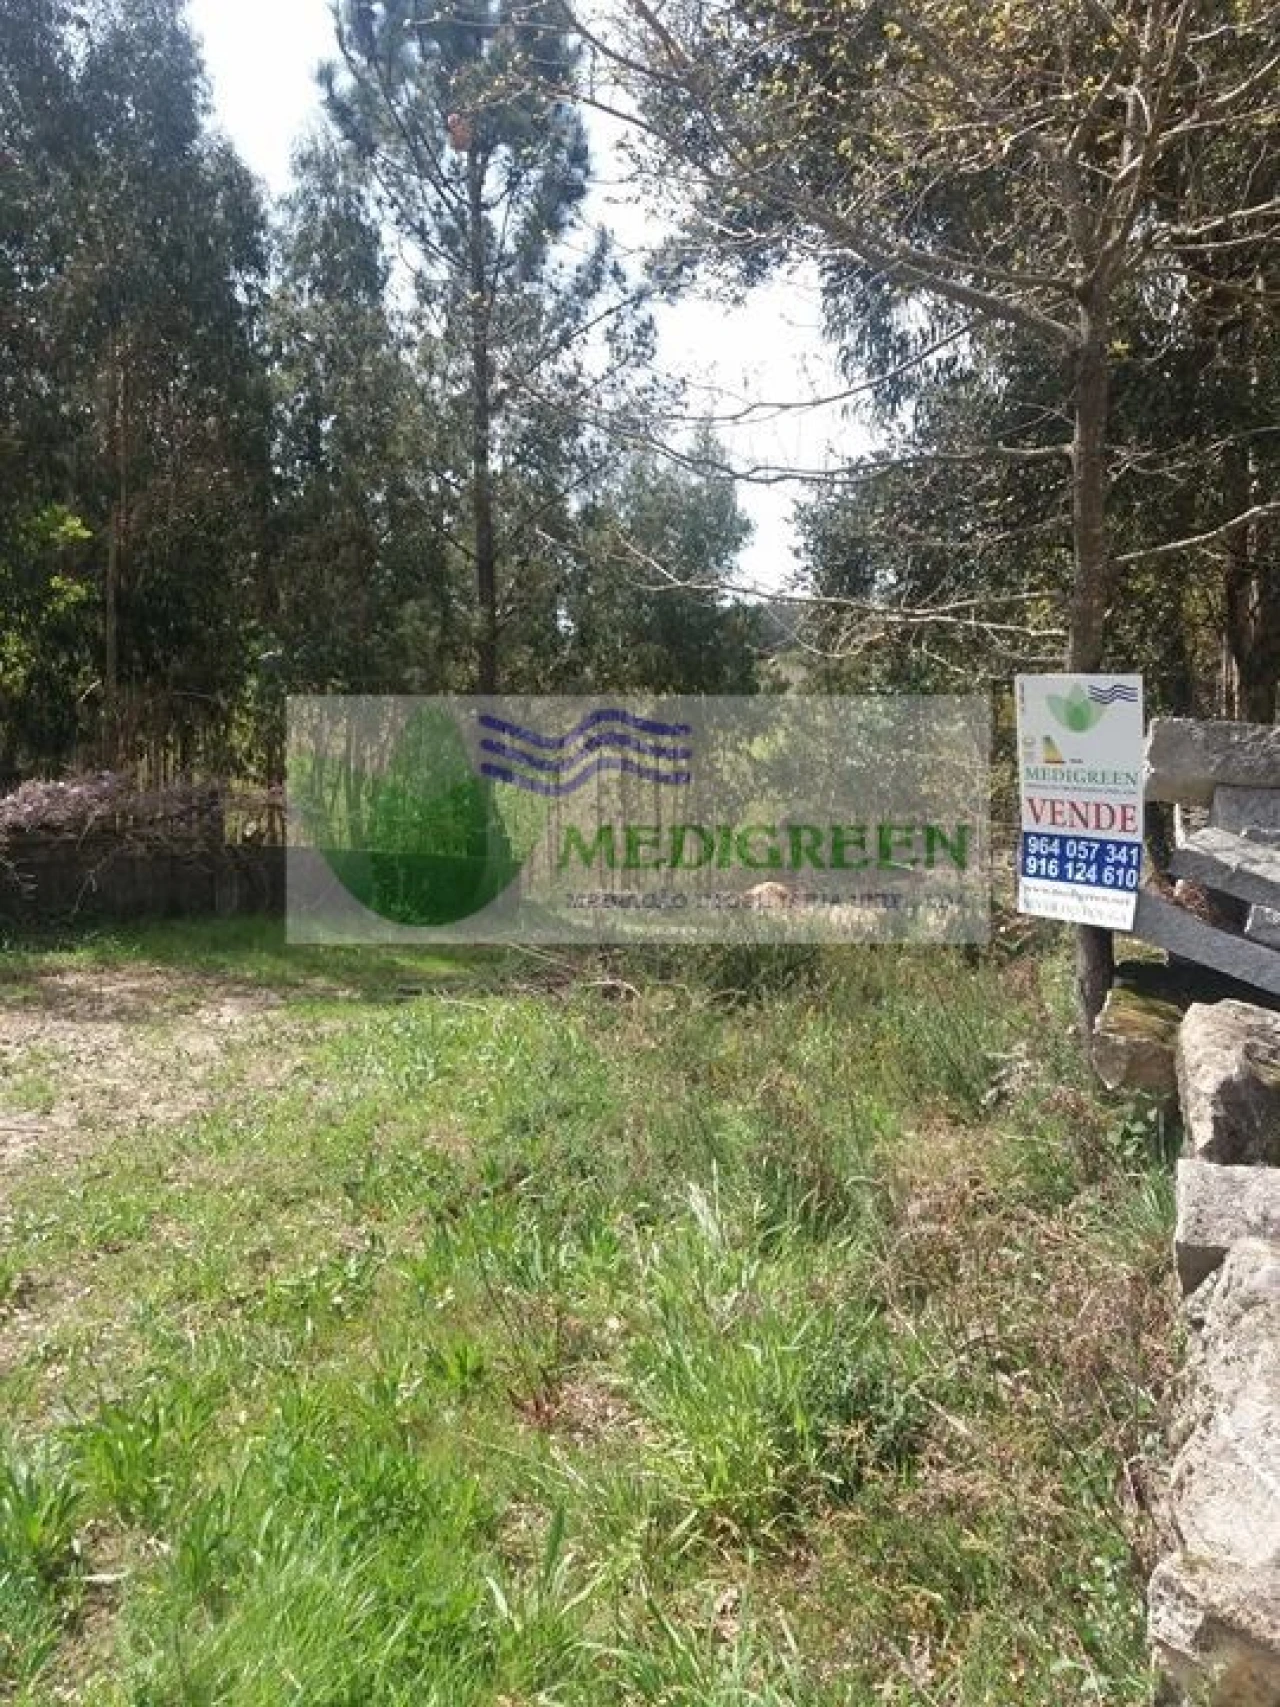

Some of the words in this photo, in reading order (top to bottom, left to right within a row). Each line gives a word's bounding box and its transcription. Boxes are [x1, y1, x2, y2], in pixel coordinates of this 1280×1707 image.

[1025, 767, 1138, 785] MEDIGREEN
[1025, 798, 1138, 833] VENDE
[1028, 836, 1060, 856] 964
[1066, 840, 1100, 860] 057
[1106, 843, 1139, 866] 341
[1026, 856, 1058, 877] 916
[1064, 862, 1097, 882] 124
[1102, 866, 1137, 888] 610
